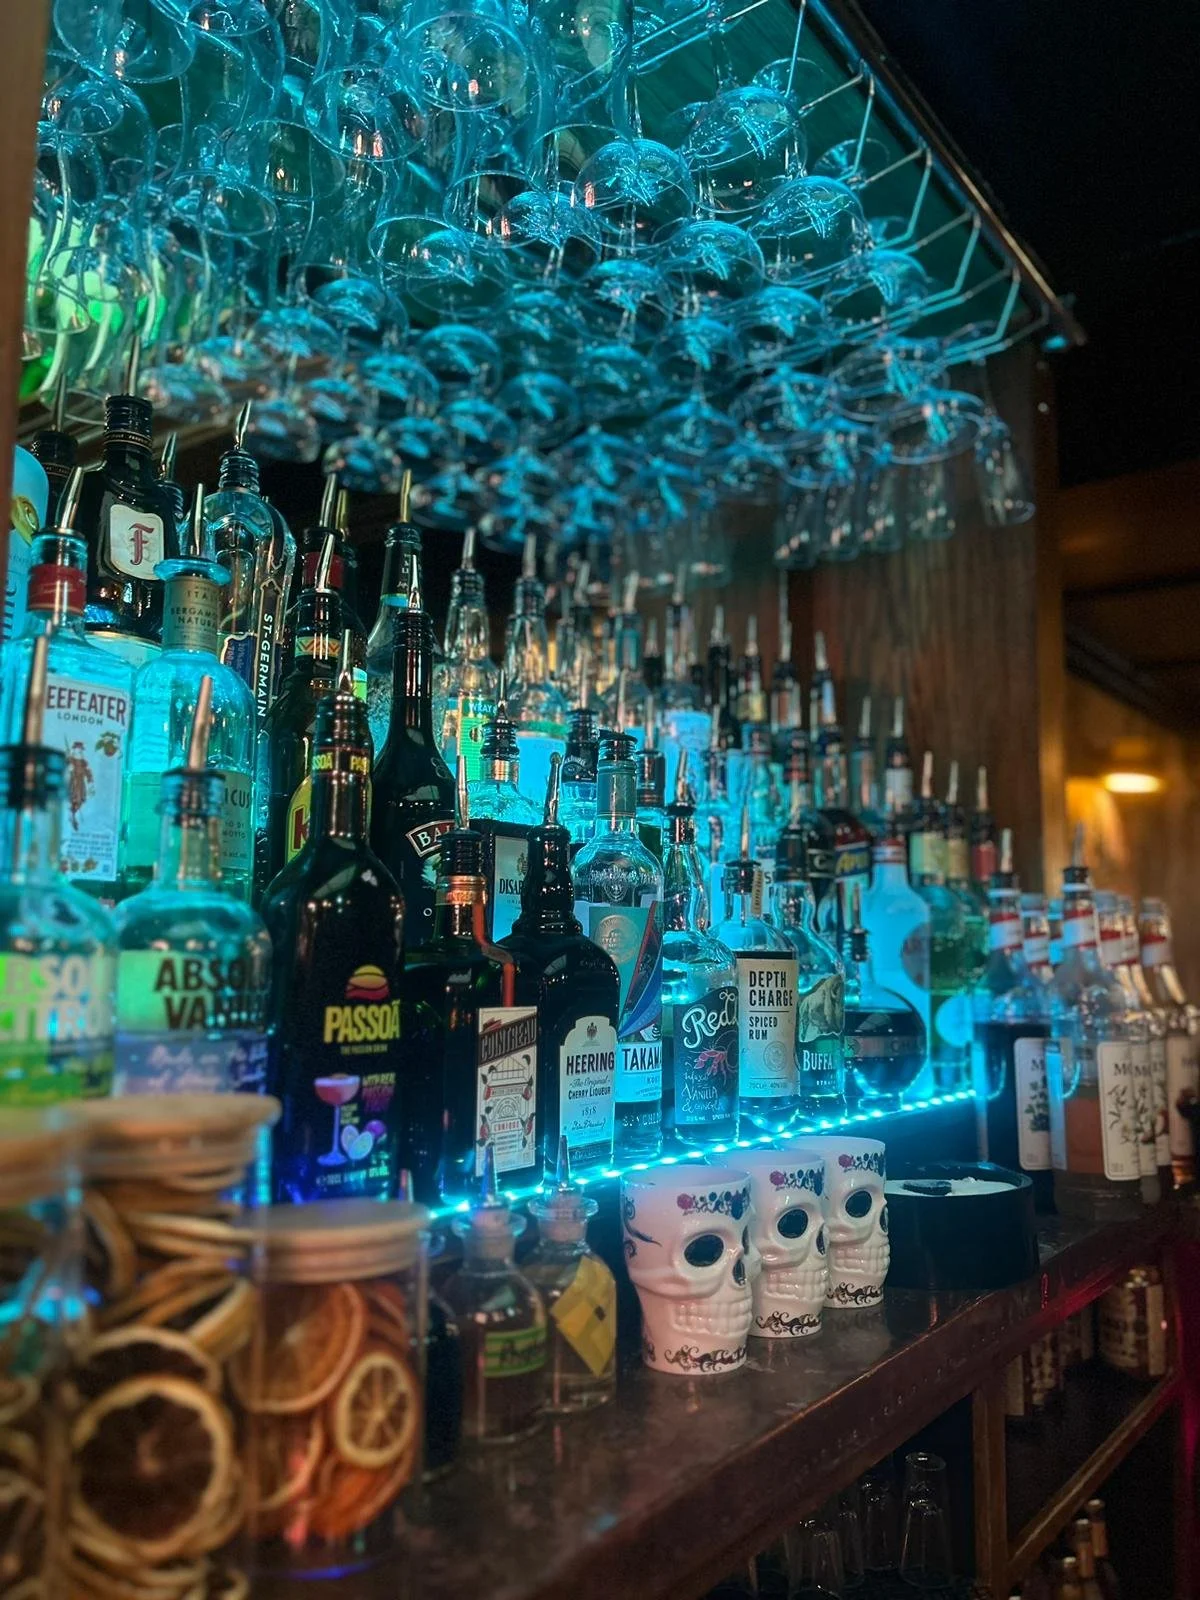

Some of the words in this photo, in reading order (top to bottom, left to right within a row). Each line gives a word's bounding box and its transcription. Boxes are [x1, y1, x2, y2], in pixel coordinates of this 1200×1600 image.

[257, 613, 273, 717] ST-GERMAIN
[46, 685, 126, 727] EEFEATER
[57, 712, 103, 726] LONDON
[749, 971, 787, 988] DEPTH
[749, 990, 793, 1007] CHARGE
[749, 1016, 778, 1028] SPICED
[481, 1015, 537, 1061] COINTREAU
[749, 1029, 768, 1040] RUM
[566, 1051, 615, 1076] HEERING
[802, 1049, 833, 1071] BUFFA
